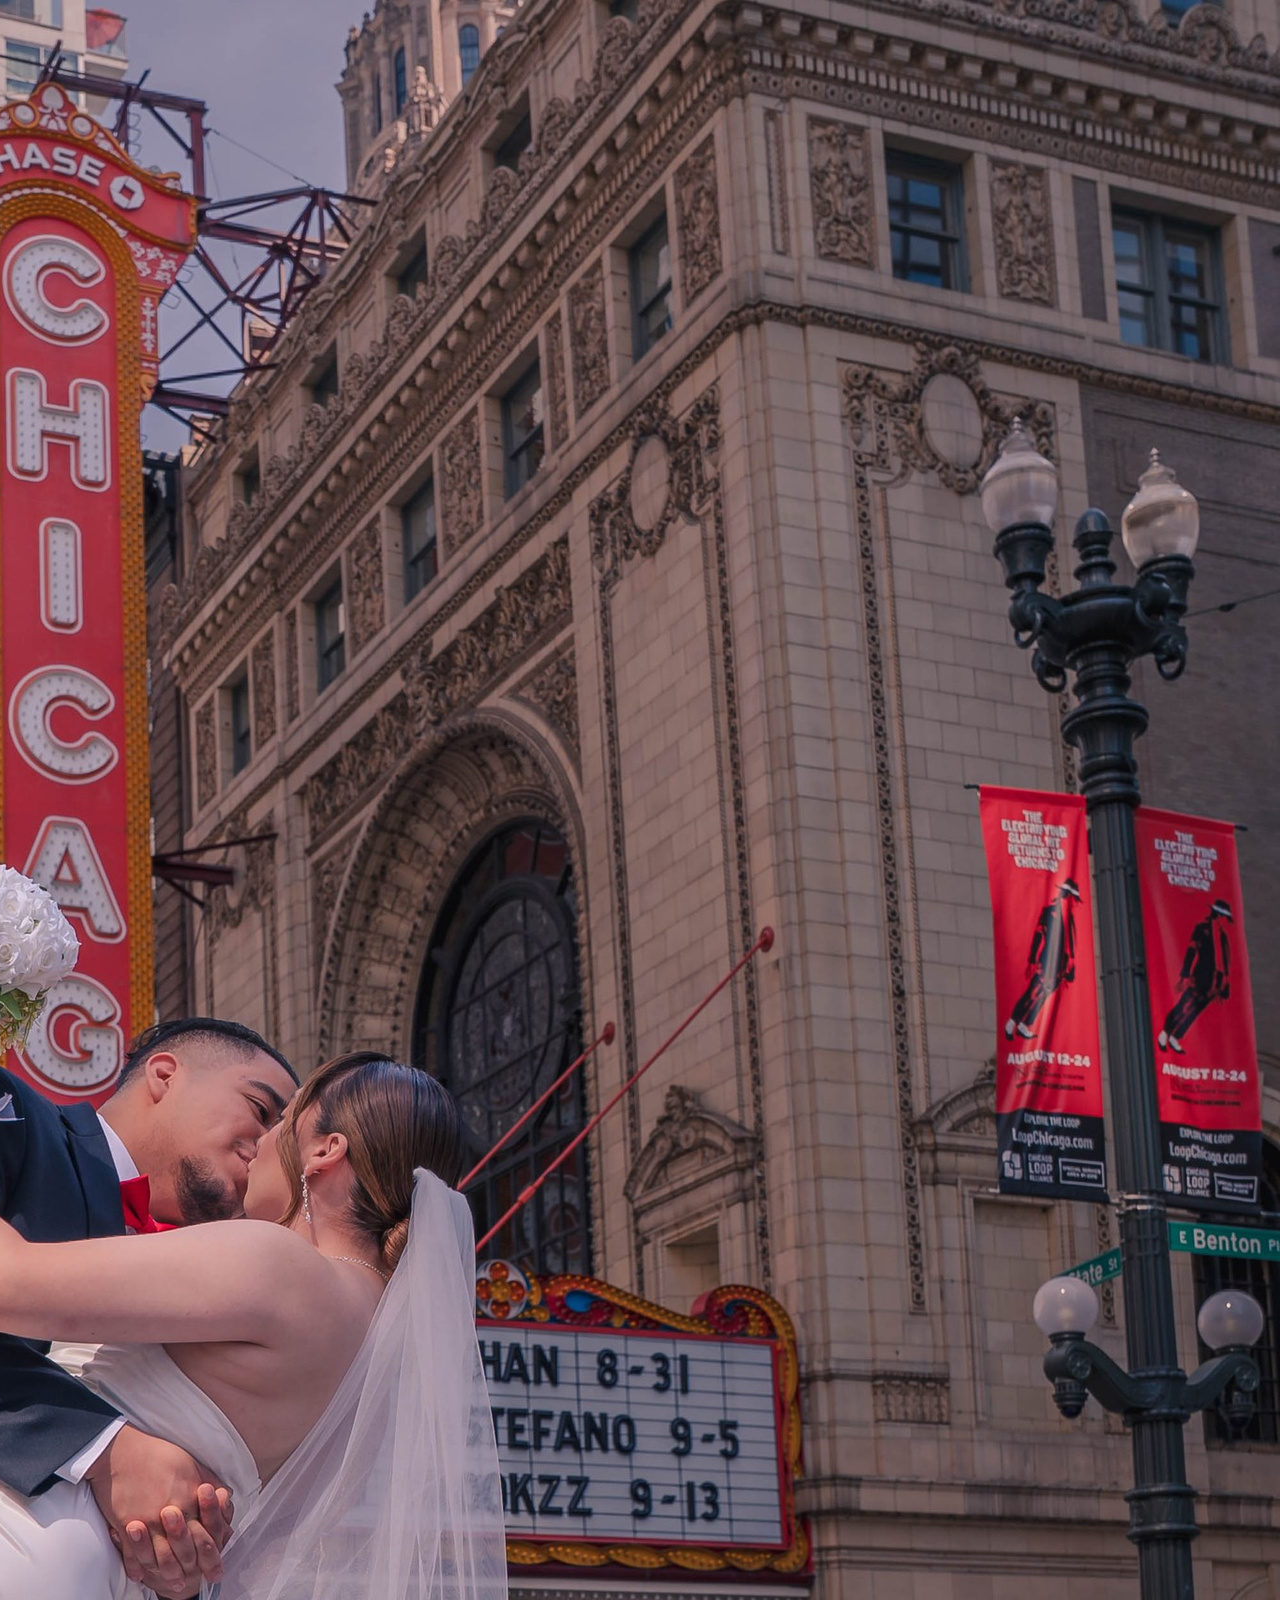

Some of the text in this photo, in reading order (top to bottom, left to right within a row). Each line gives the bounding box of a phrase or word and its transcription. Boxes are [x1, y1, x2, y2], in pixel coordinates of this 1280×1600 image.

[1022, 809, 1042, 823] THE
[1001, 818, 1068, 838] ELECTRIFYING
[1008, 832, 1061, 849] GLOBAL HIT
[1175, 830, 1193, 845] THE
[1008, 842, 1065, 860] RETURNS TO
[1161, 851, 1196, 867] GLOBAL
[1161, 861, 1216, 881] RETURNS TO
[1007, 1048, 1091, 1068] AUGUST 12-24
[1162, 1063, 1247, 1082] AUGUST 12-24
[1063, 1116, 1081, 1129] LOOP
[1012, 1127, 1094, 1151] LoopChicago.com
[1214, 1133, 1235, 1145] LOOP
[1169, 1141, 1248, 1166] LoopChicago.com
[1029, 1162, 1053, 1175] LOOP
[1186, 1176, 1210, 1189] LOOP
[1179, 1230, 1187, 1245] E
[1193, 1228, 1261, 1254] Benton
[1108, 1257, 1118, 1271] St
[596, 1349, 690, 1395] 8-31
[490, 1406, 740, 1460] TEFANO 9-5
[629, 1478, 720, 1522] 9-13
